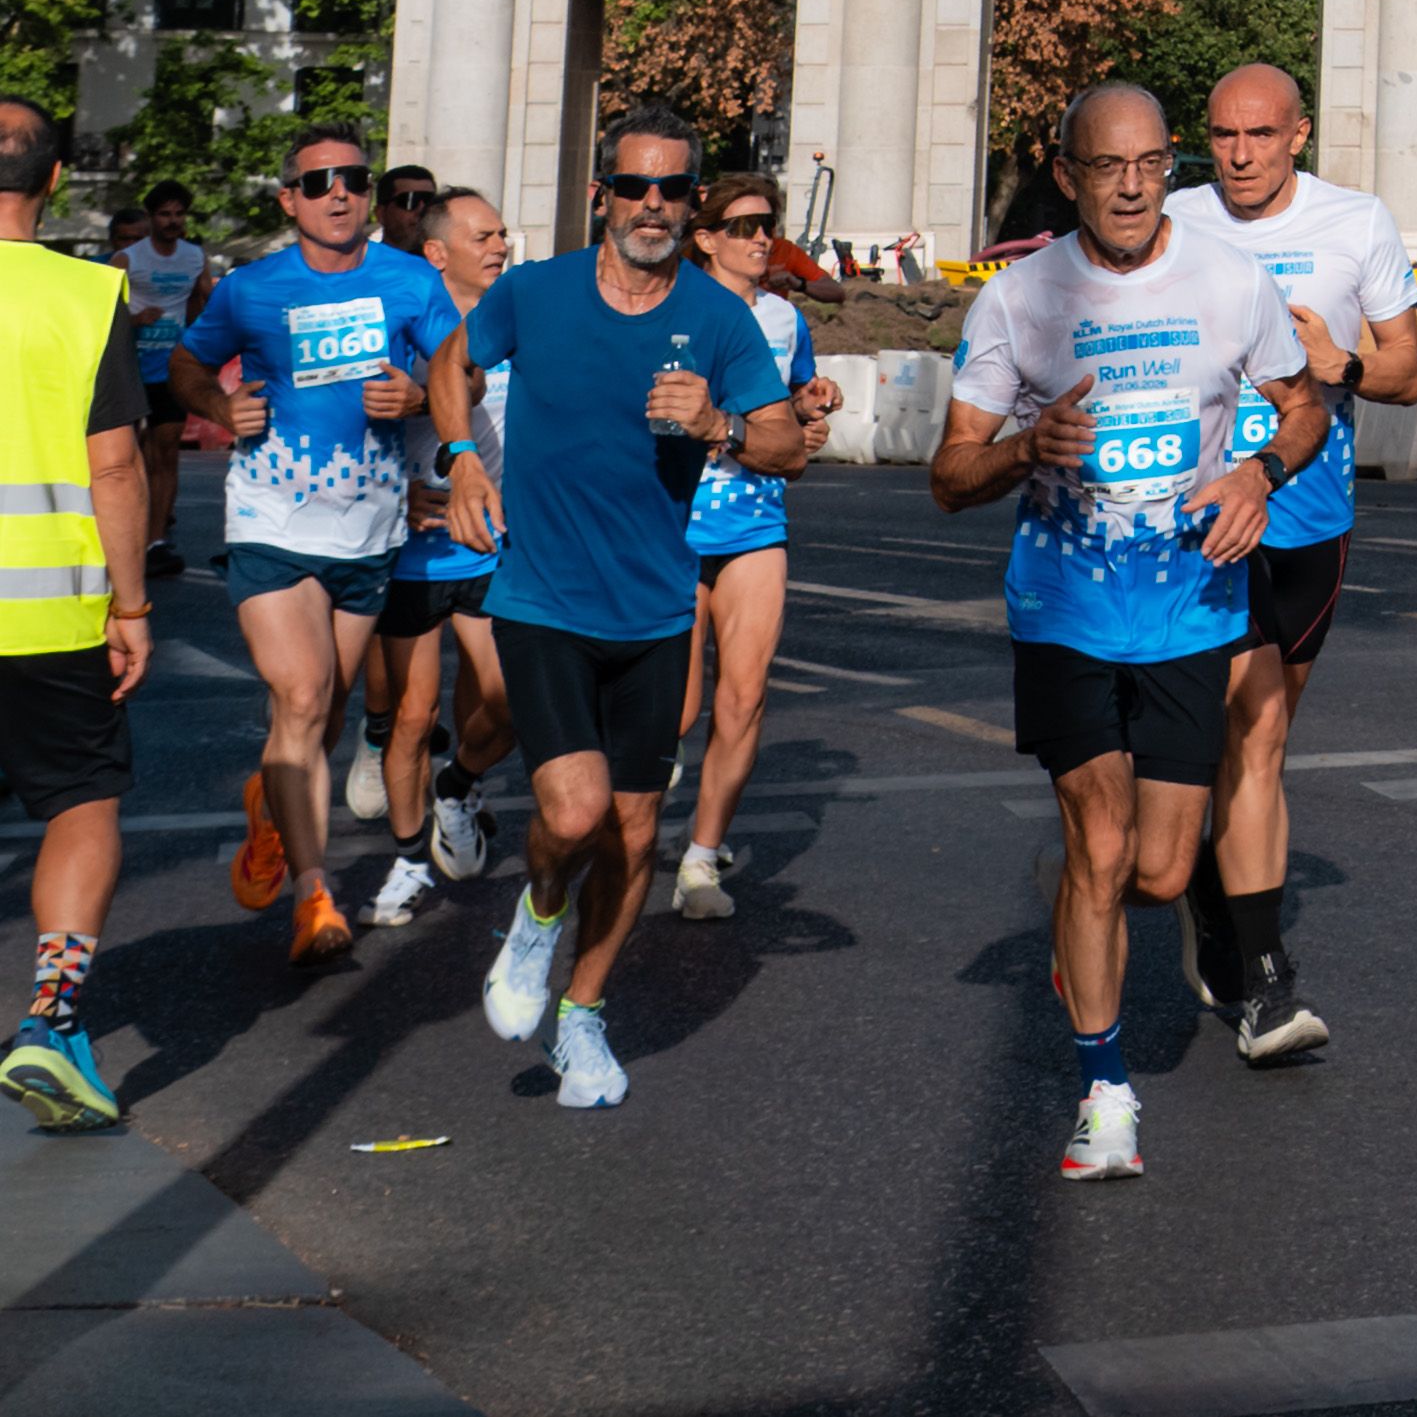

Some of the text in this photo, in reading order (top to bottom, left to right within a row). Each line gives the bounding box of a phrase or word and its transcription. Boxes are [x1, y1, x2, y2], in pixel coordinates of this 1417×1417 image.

[1073, 326, 1102, 339] KLM
[1107, 322, 1133, 332] Royal
[1136, 319, 1165, 329] Dutch
[298, 328, 385, 363] 1060
[1075, 330, 1199, 359] NORTE VS SUR
[1098, 358, 1181, 382] Run Well
[1098, 434, 1182, 473] 668
